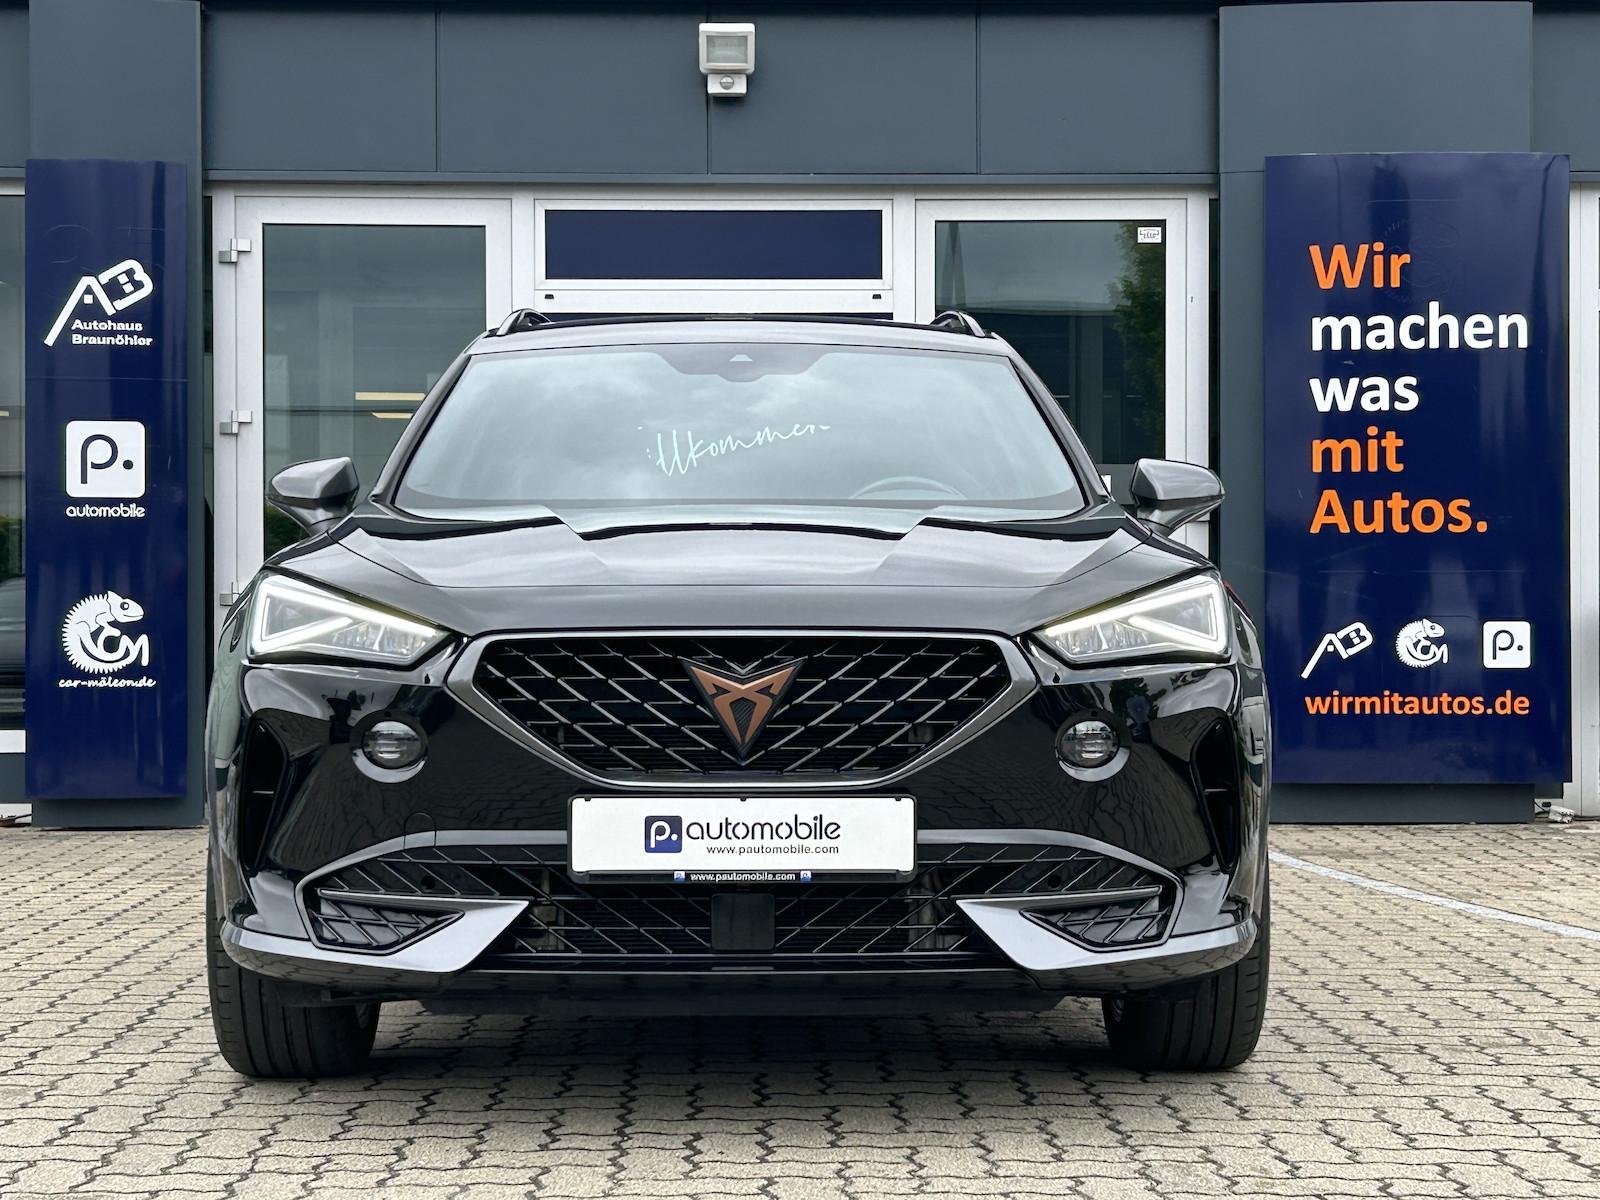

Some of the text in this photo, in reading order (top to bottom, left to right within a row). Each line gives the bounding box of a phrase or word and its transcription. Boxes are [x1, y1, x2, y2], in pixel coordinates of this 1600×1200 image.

[1308, 241, 1411, 289] Wir
[71, 318, 143, 331] Autohaus
[1311, 300, 1529, 351] machen
[71, 333, 153, 346] Braunöhler
[1308, 375, 1419, 413] was
[1311, 425, 1404, 473] mit
[65, 502, 146, 518] automobile
[1309, 489, 1488, 534] Autos.
[1304, 689, 1530, 715] wirmitautos.de
[685, 813, 841, 841] automobile
[706, 844, 840, 855] www.pautomobile.com
[690, 871, 796, 883] www.pautomobile.com
